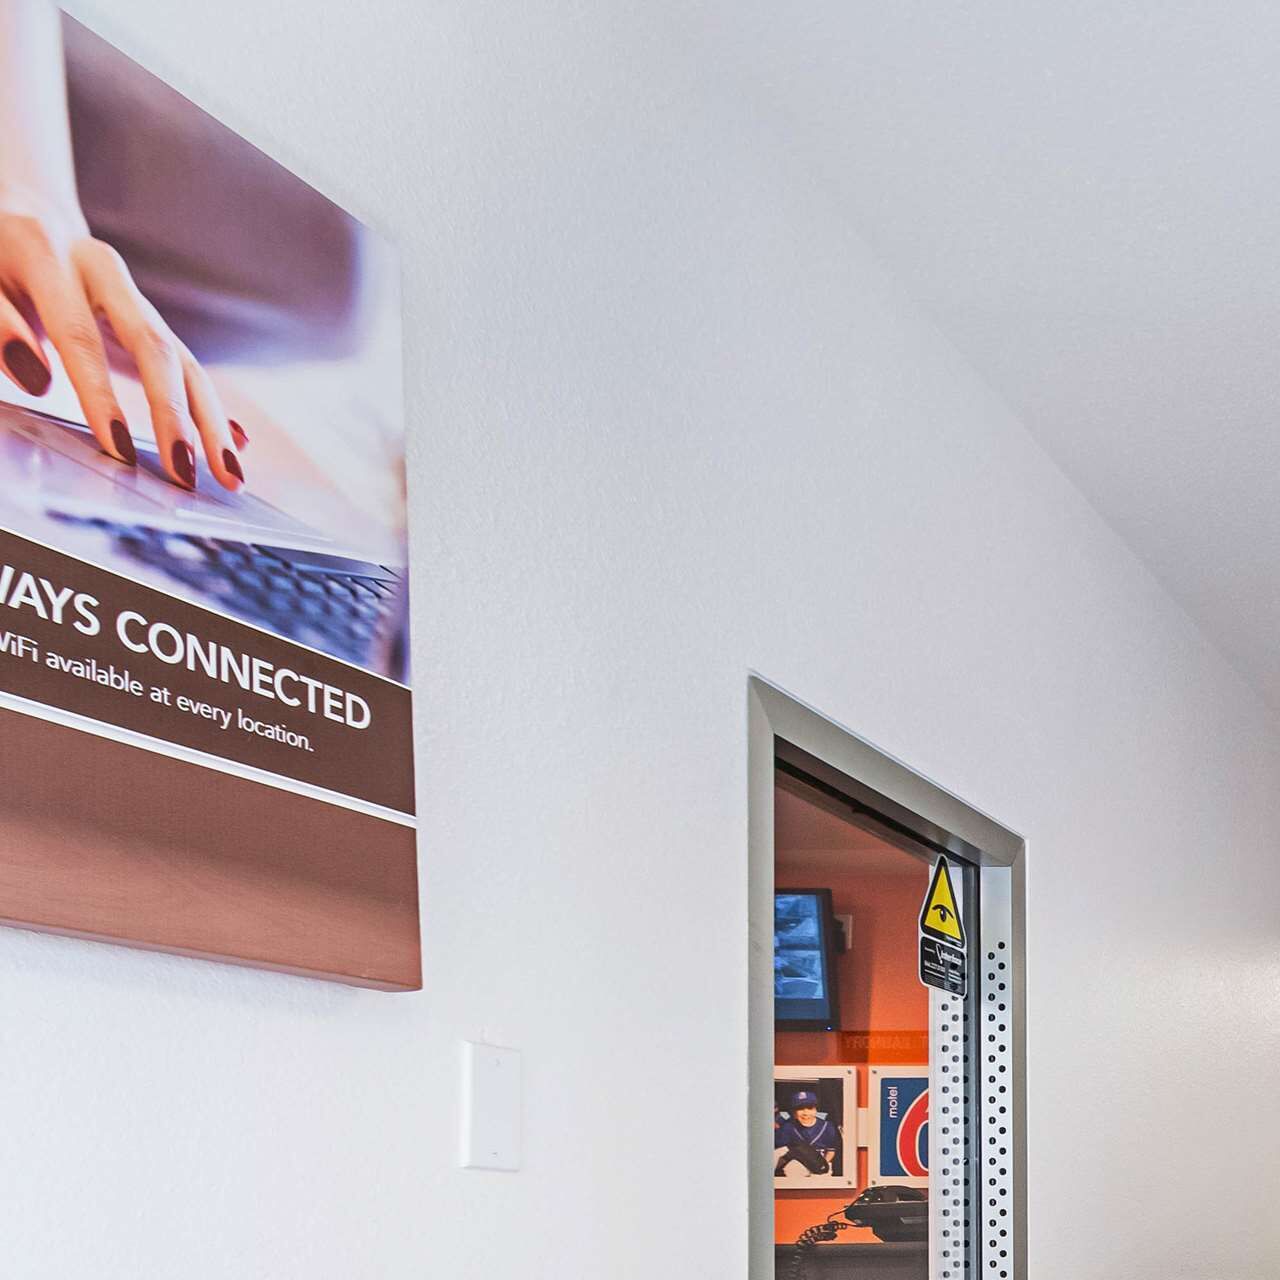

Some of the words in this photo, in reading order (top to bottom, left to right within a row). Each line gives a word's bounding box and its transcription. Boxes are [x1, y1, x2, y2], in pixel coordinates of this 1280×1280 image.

[46, 651, 143, 696] available
[150, 686, 172, 707] at
[177, 694, 232, 730] every
[238, 708, 314, 752] location.
[116, 610, 371, 730] CONNECTED
[888, 1086, 898, 1118] motel
